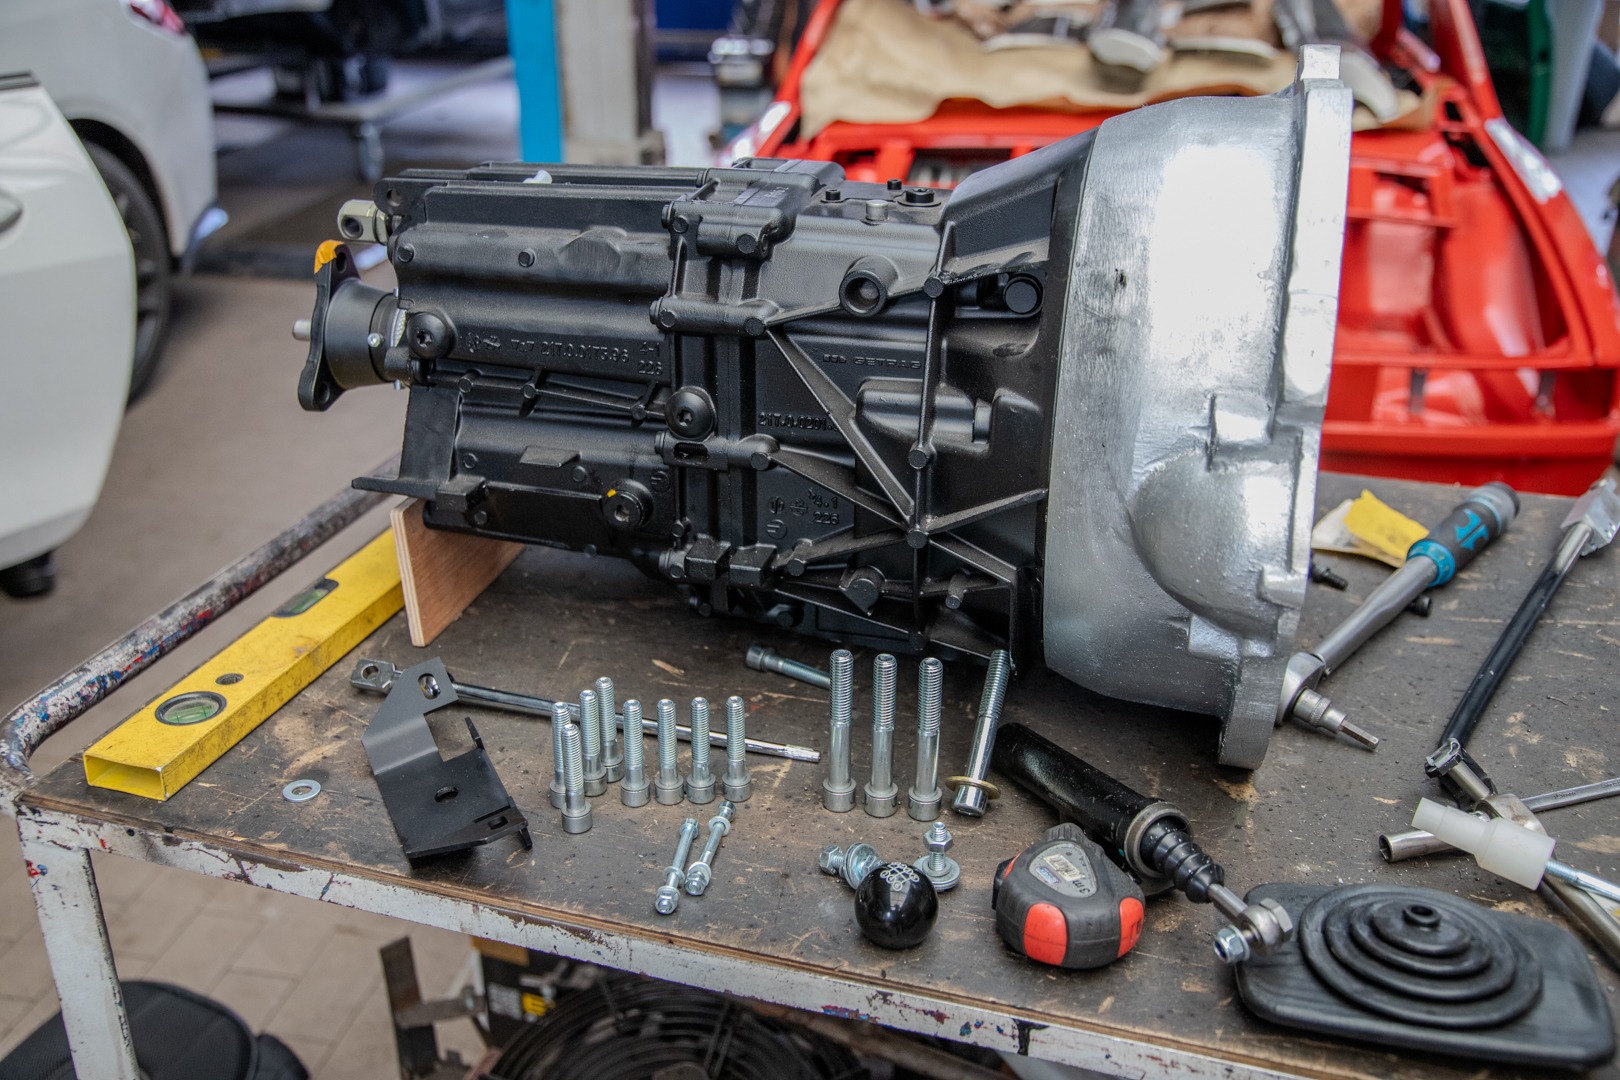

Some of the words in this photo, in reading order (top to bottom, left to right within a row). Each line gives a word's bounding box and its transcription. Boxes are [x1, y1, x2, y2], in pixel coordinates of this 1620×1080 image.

[638, 360, 663, 376] 226
[854, 356, 922, 370] GETRAG
[813, 511, 840, 525] 226
